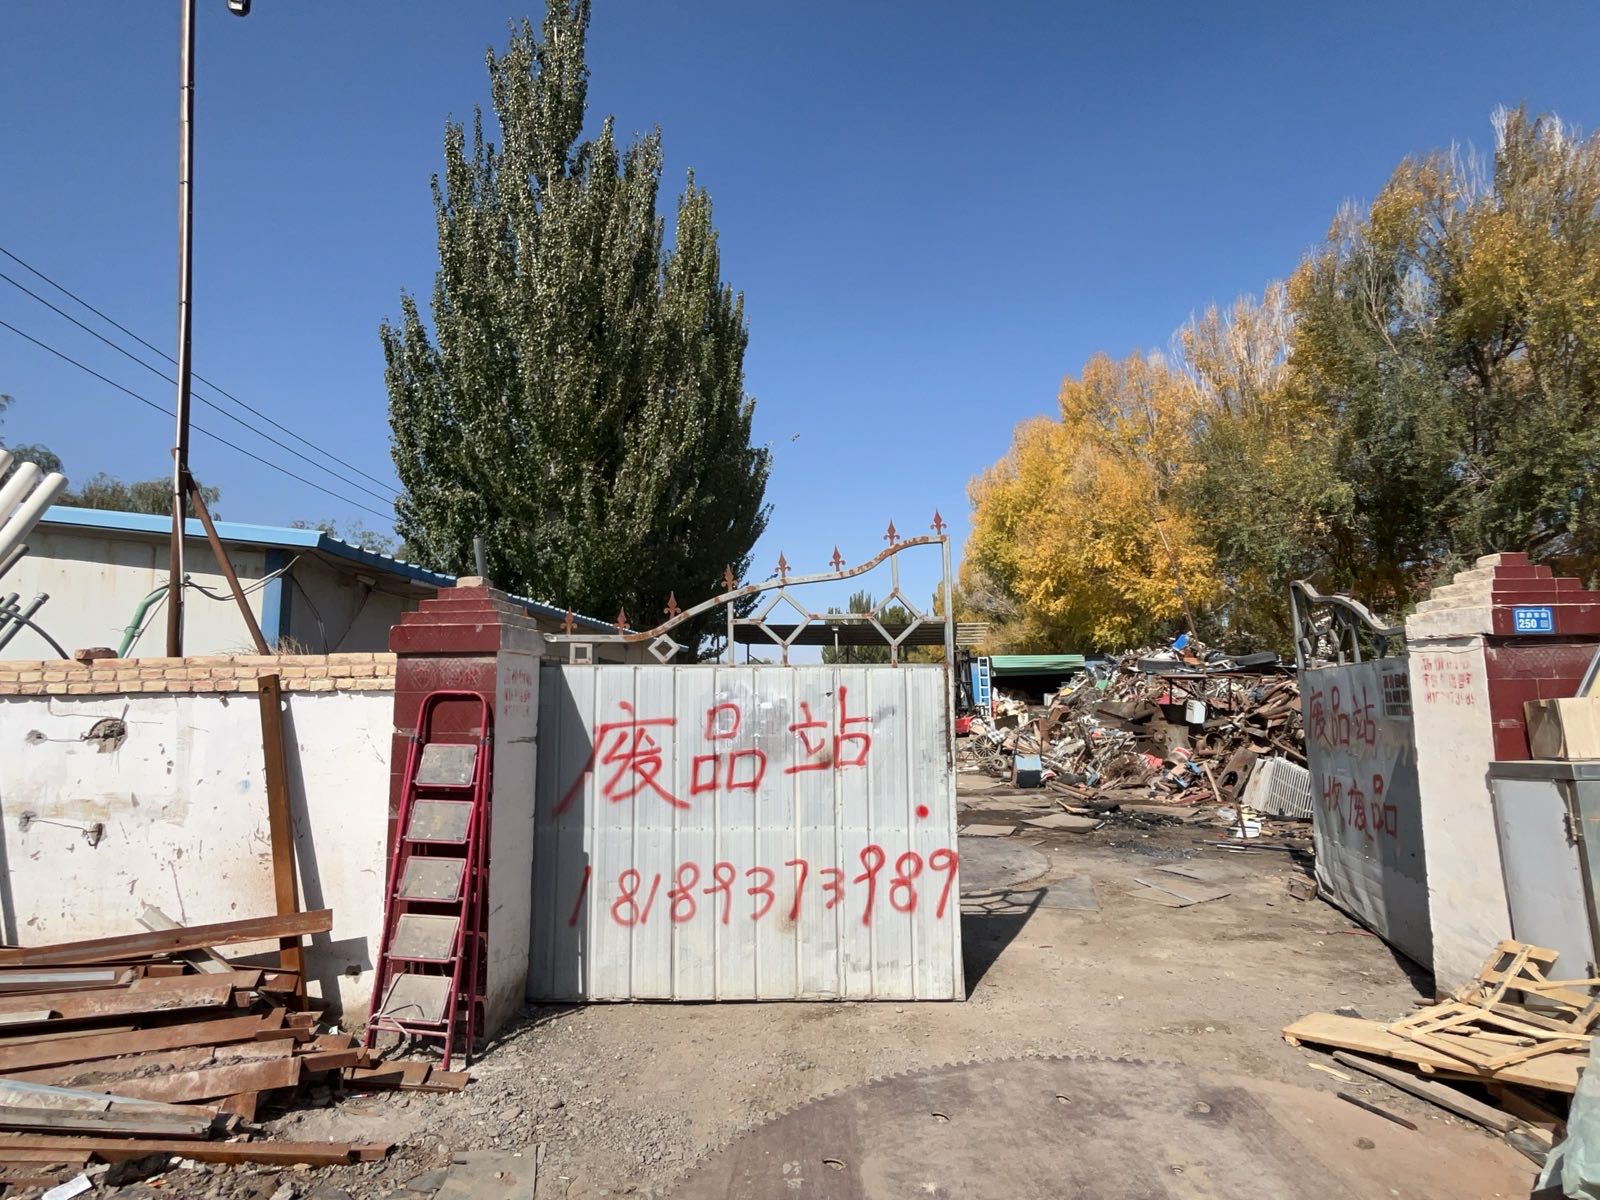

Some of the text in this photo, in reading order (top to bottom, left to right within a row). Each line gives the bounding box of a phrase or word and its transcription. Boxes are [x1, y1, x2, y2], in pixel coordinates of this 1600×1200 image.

[1518, 618, 1537, 629] 250
[554, 685, 874, 816] 废品站
[1308, 686, 1377, 749] 废品站
[570, 844, 960, 928] 18189373989
